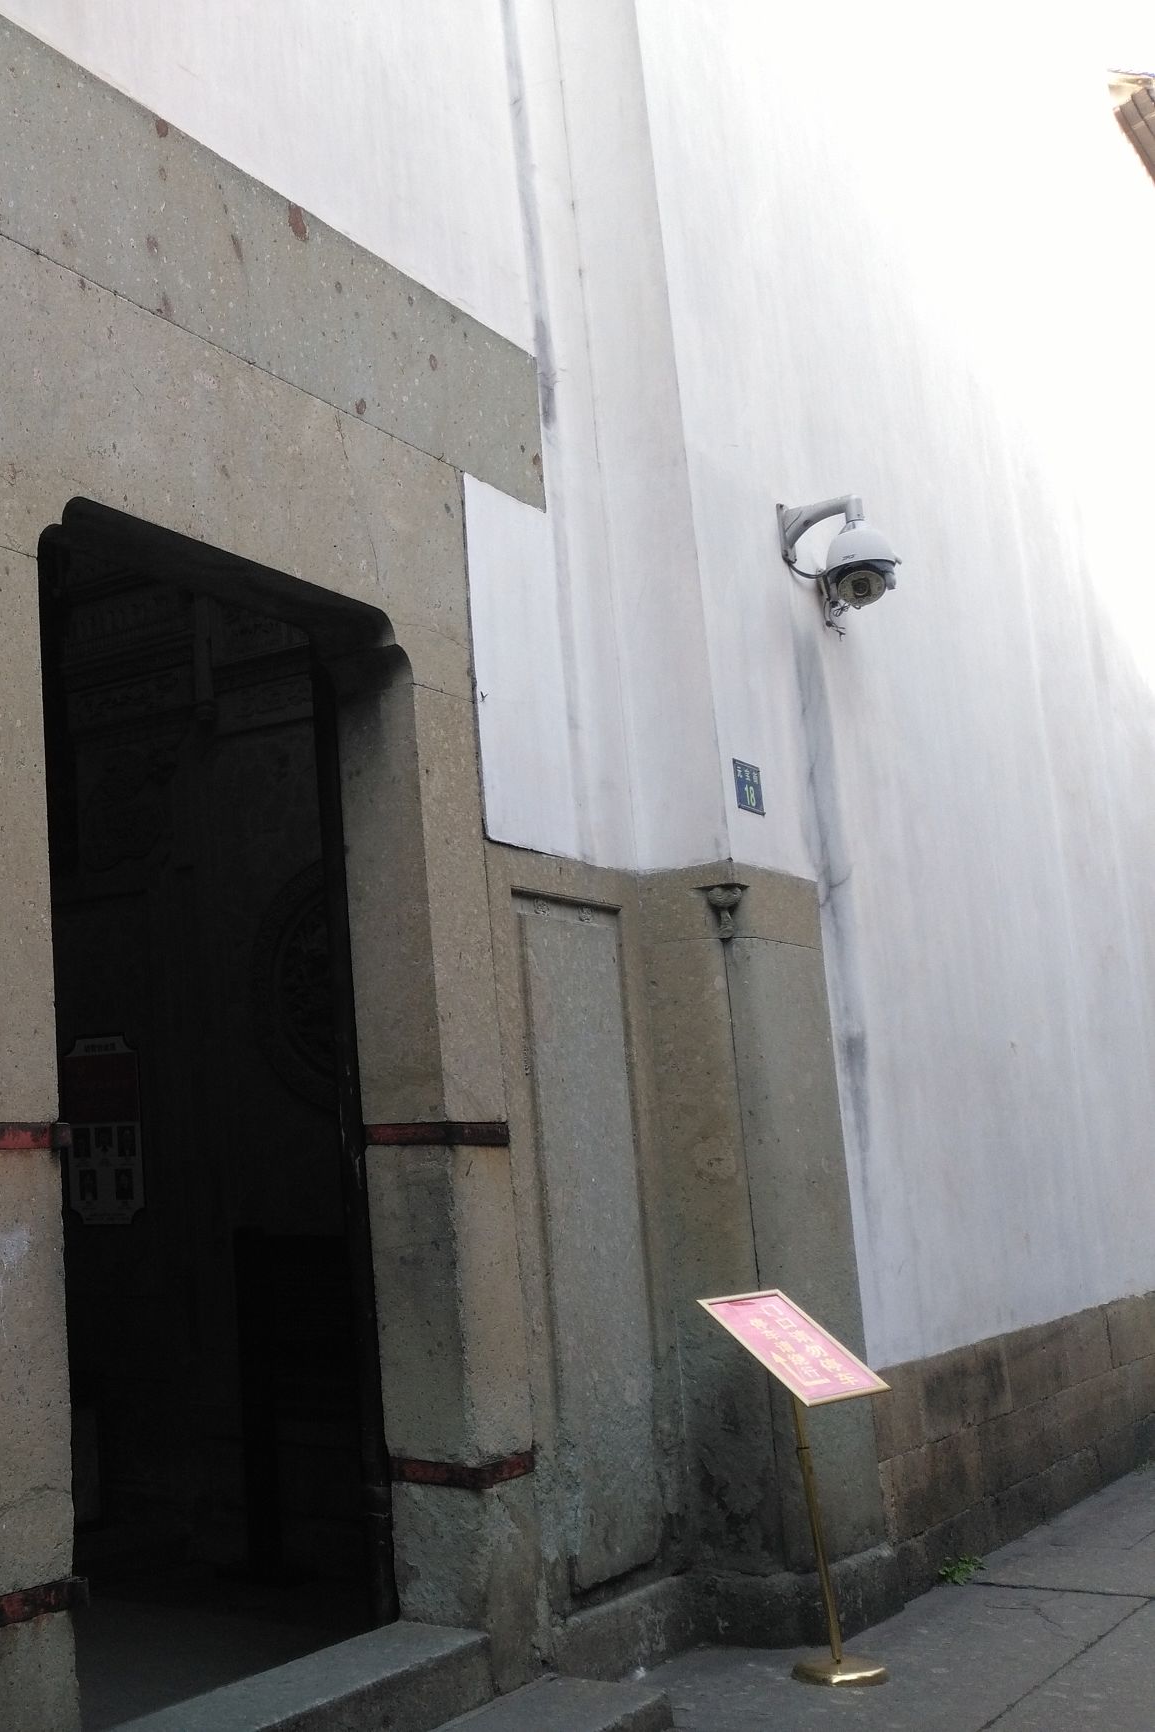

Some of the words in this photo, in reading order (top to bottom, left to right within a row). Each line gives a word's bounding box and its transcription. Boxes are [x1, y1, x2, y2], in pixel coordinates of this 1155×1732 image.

[744, 784, 757, 807] 18
[760, 1303, 859, 1386] 门口请勿停车
